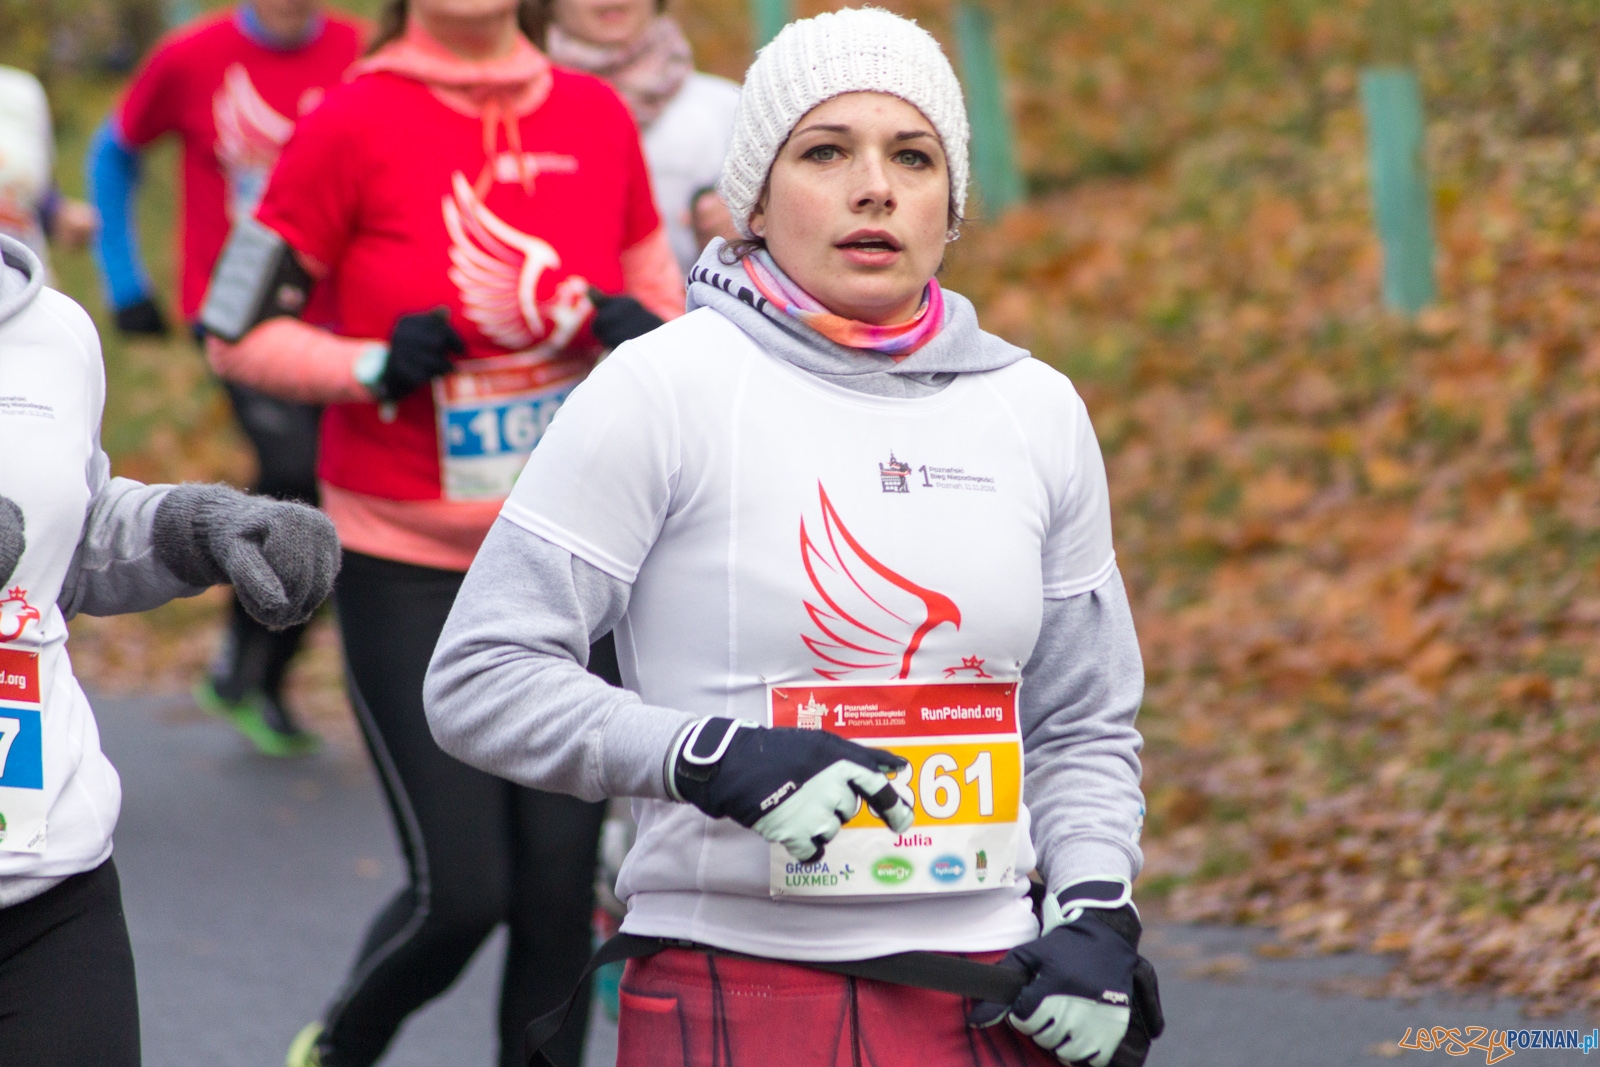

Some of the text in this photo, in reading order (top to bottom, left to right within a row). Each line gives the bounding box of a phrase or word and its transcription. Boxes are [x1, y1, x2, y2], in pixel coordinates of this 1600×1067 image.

[918, 465, 934, 487] 1
[929, 466, 965, 474] Poznański
[930, 473, 995, 484] Bieg Niepodległości
[844, 704, 879, 712] Poznański
[920, 704, 1003, 722] RunPoland.org
[833, 703, 847, 727] 1
[844, 710, 906, 719] Bieg Niepodległości
[875, 718, 906, 726] 11.11.2016
[853, 751, 995, 820] 861
[893, 834, 933, 848] Julia
[785, 875, 839, 887] LUXMED
